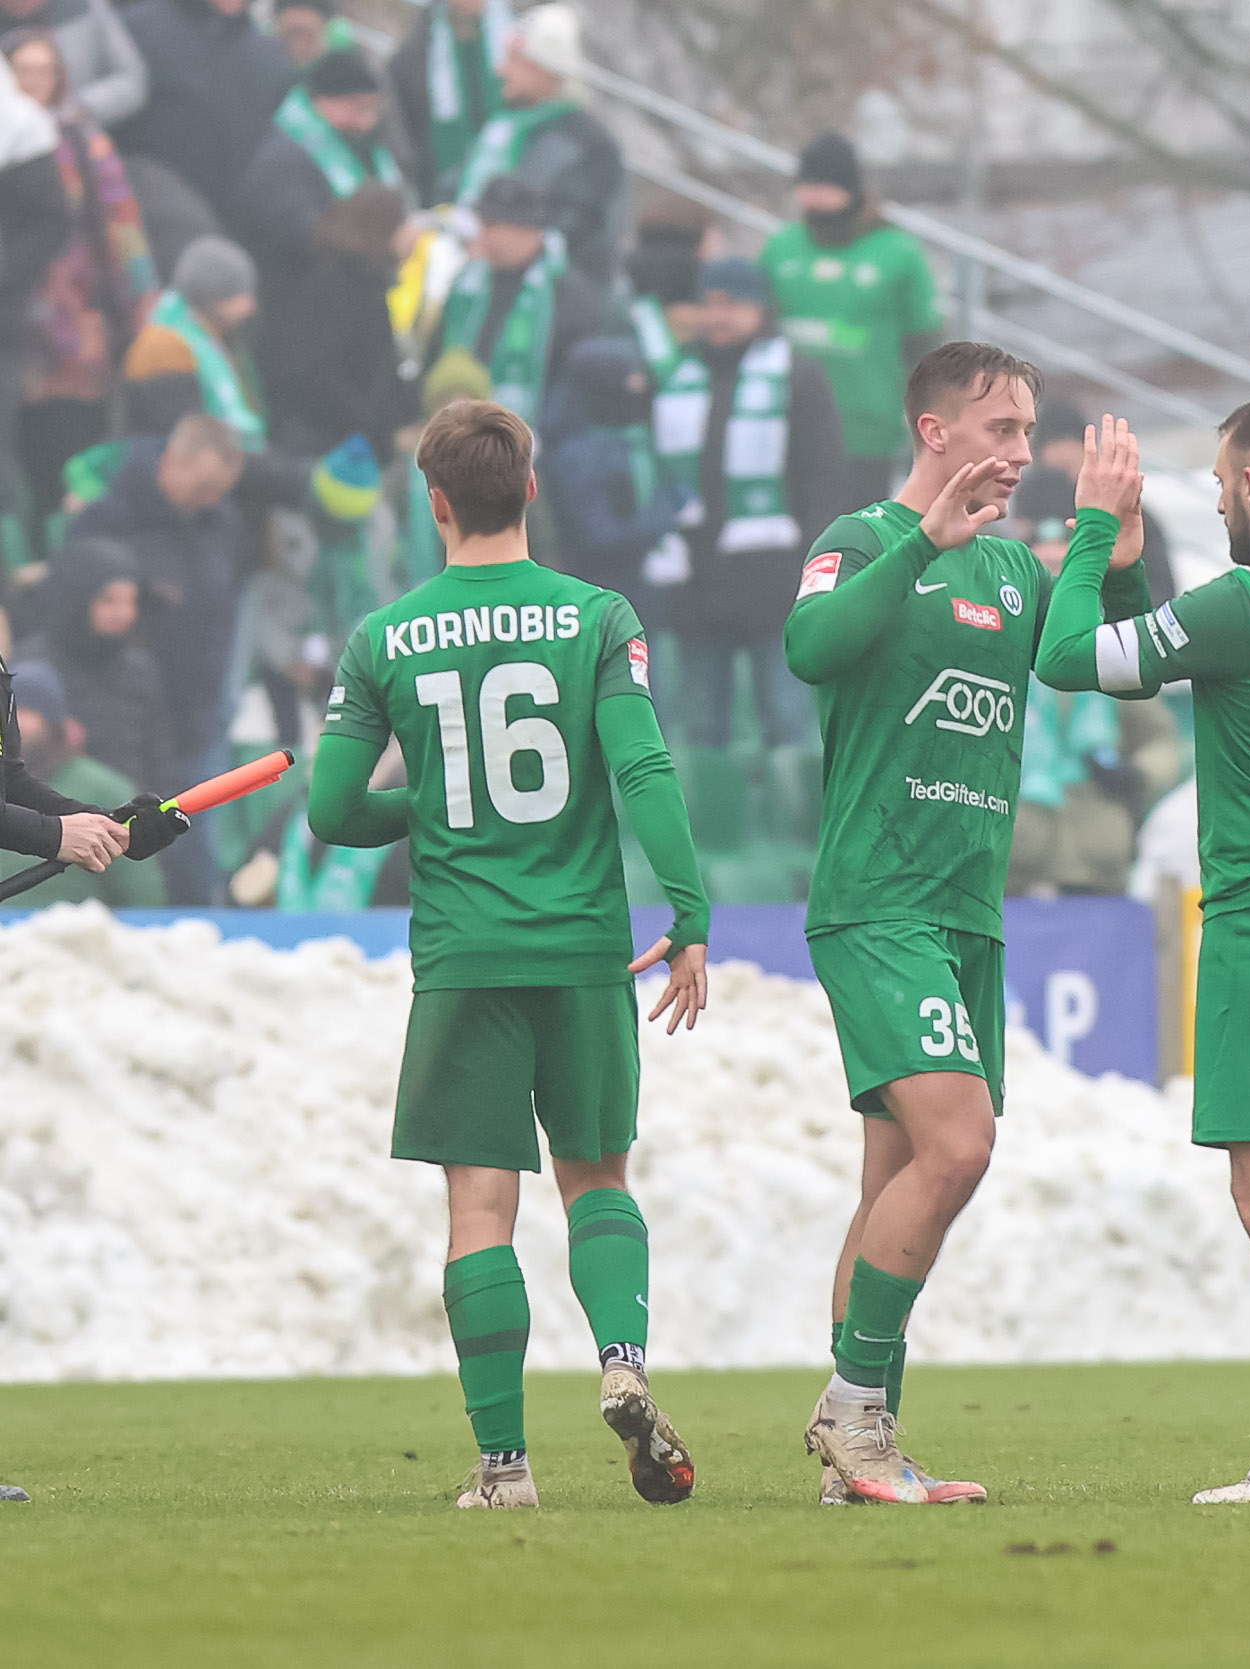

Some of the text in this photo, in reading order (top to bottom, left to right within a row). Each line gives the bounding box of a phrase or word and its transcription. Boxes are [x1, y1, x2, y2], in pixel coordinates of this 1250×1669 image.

[385, 604, 580, 661] KORNOBIS
[958, 603, 998, 627] Betclic
[414, 661, 571, 829] 16
[905, 775, 1009, 815] TedGifted.cm
[918, 996, 980, 1062] 35
